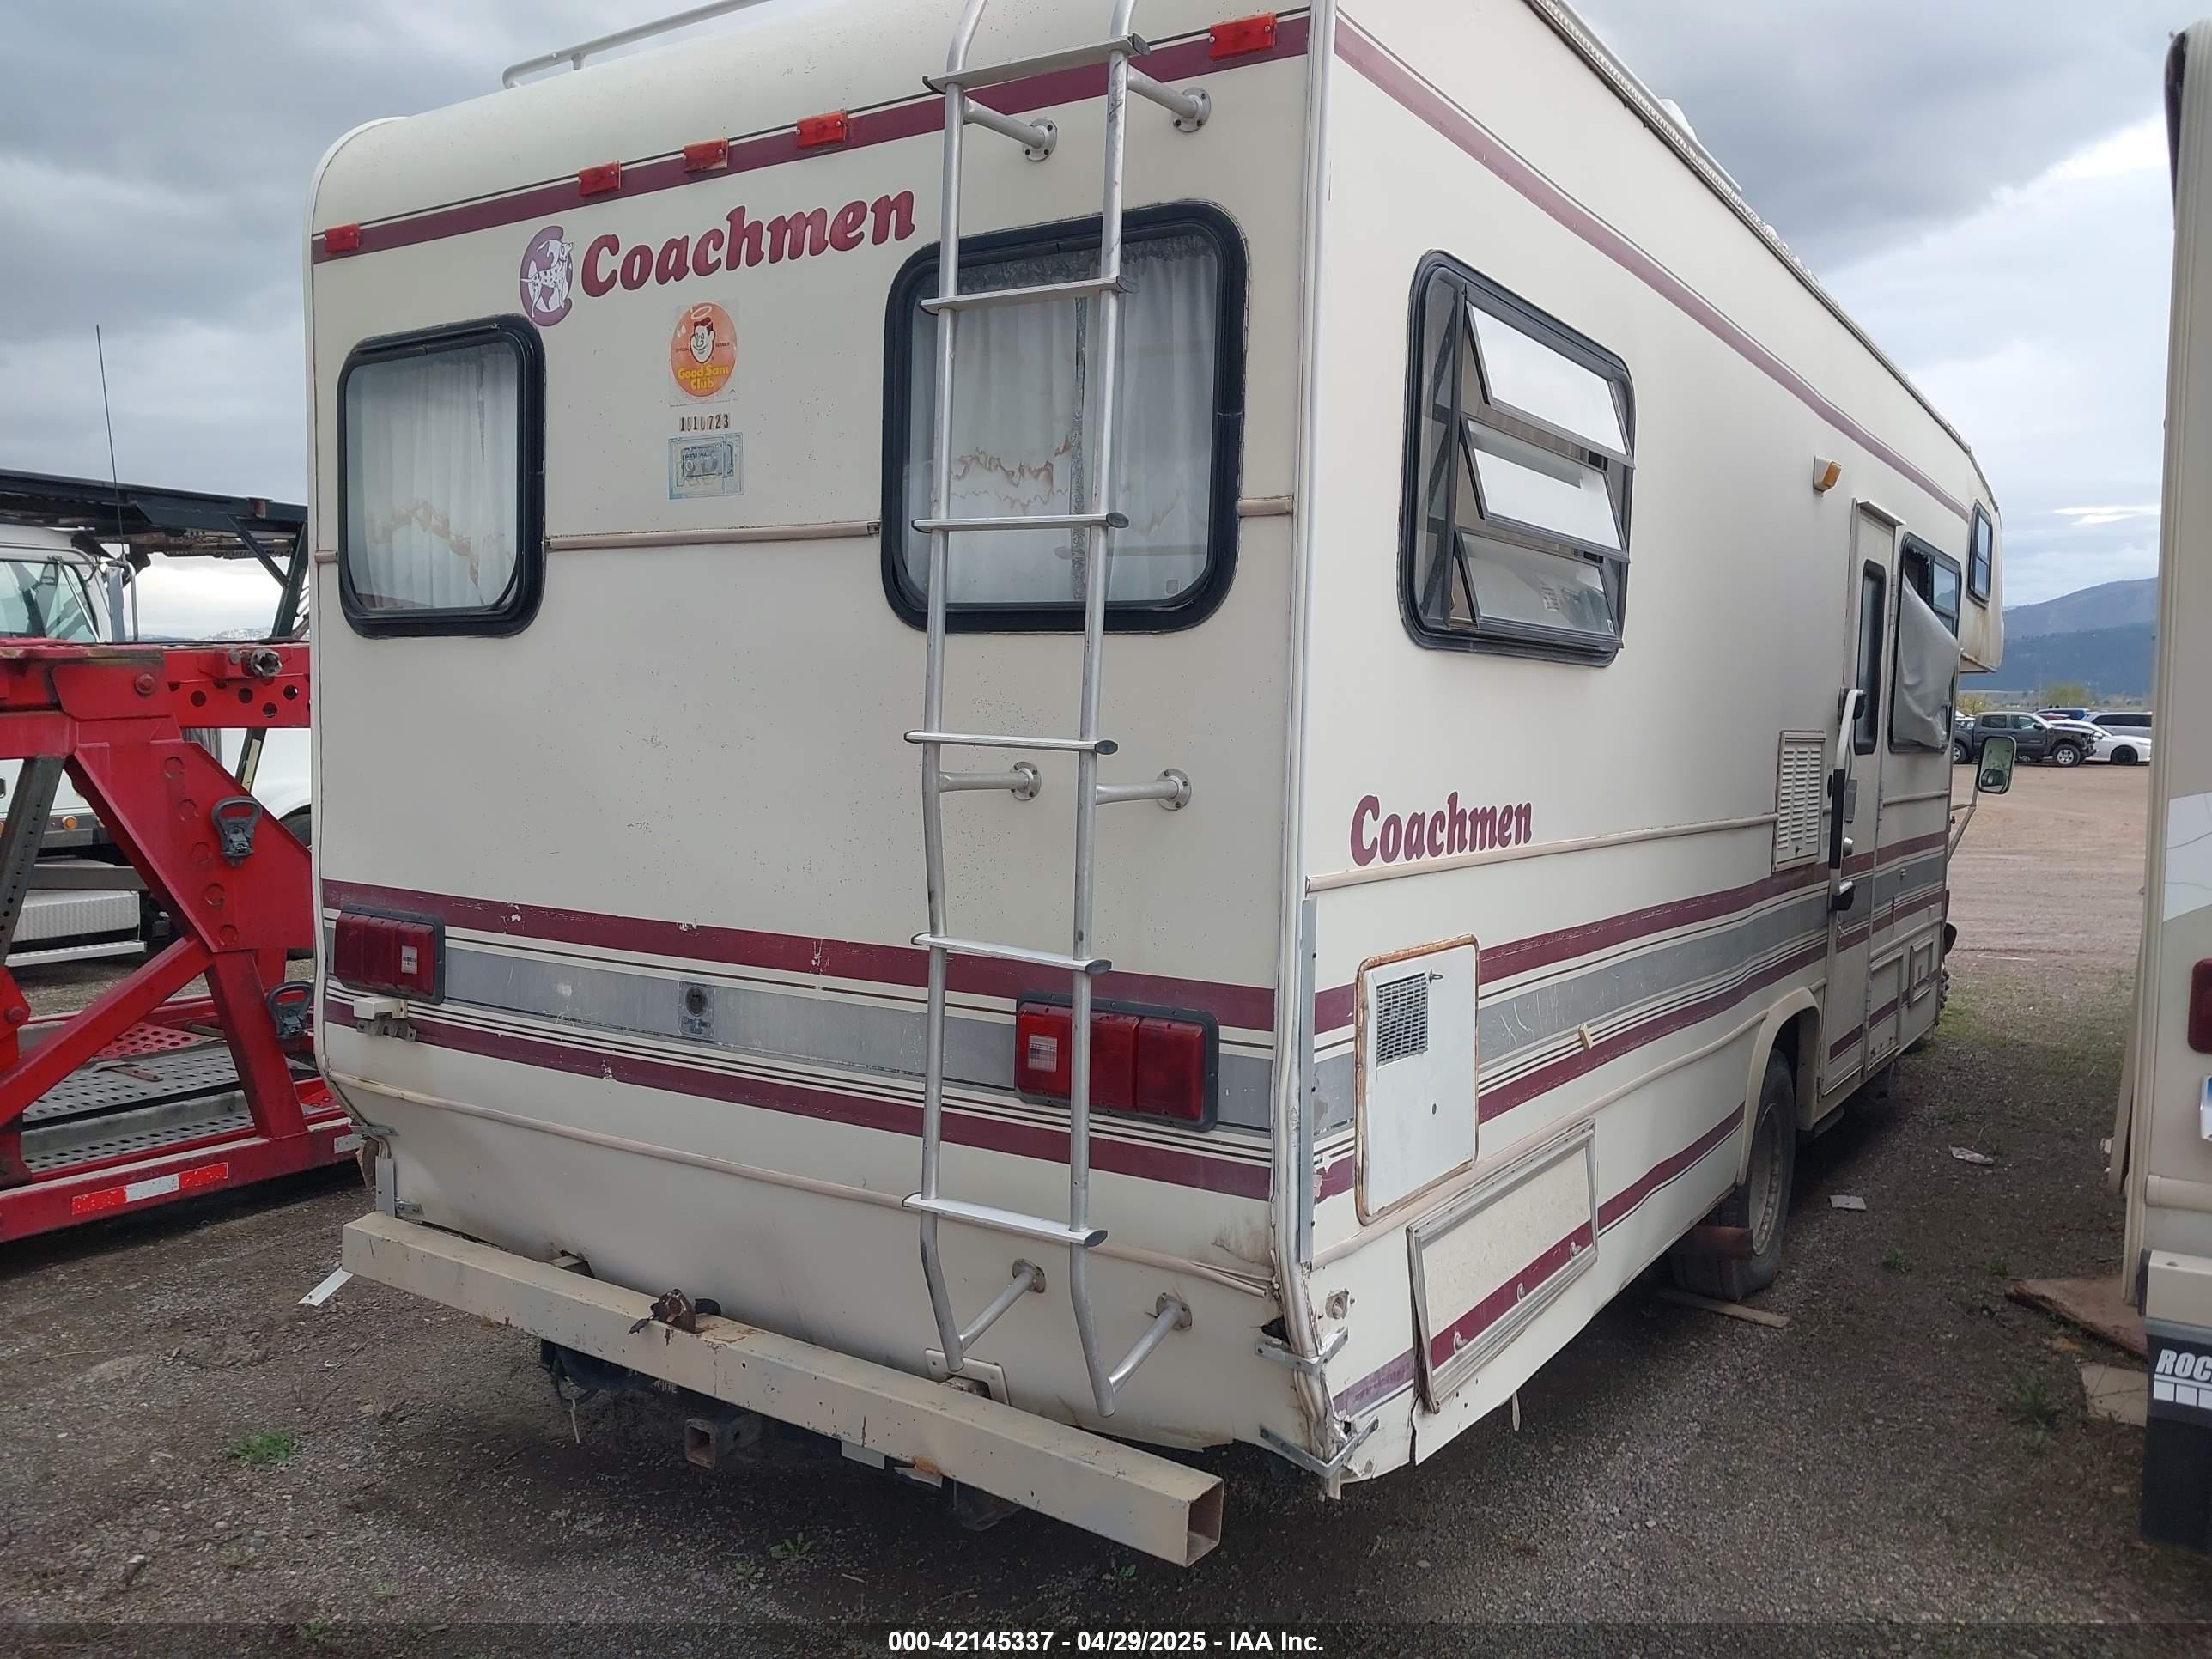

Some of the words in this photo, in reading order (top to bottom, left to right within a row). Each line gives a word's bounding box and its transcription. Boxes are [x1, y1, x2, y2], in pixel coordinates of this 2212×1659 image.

[581, 190, 915, 298] Coachmen
[677, 365, 704, 380] Good
[704, 363, 729, 376] Sam
[690, 378, 714, 390] Club
[1350, 791, 1532, 867] Coachmen
[2155, 1348, 2212, 1382] ROC
